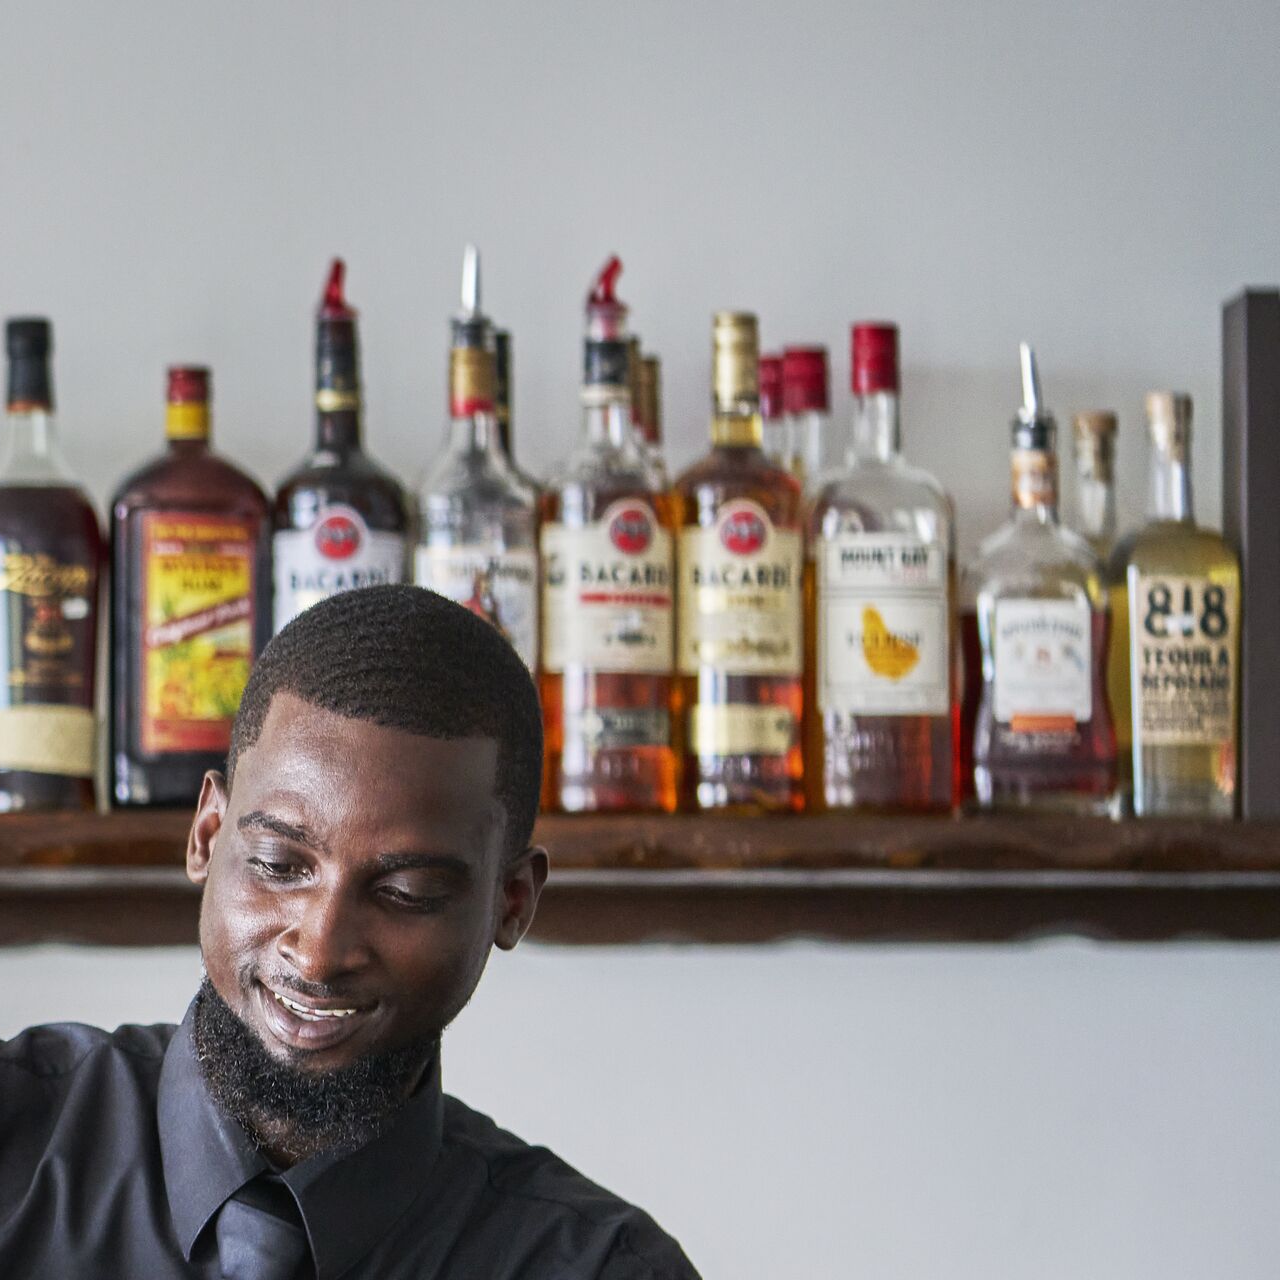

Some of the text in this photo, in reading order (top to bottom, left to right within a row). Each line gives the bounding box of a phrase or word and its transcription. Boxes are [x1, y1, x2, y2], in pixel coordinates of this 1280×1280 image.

[841, 547, 894, 566] MOUNT
[1144, 582, 1229, 640] 818
[1143, 646, 1228, 666] TEQUILA
